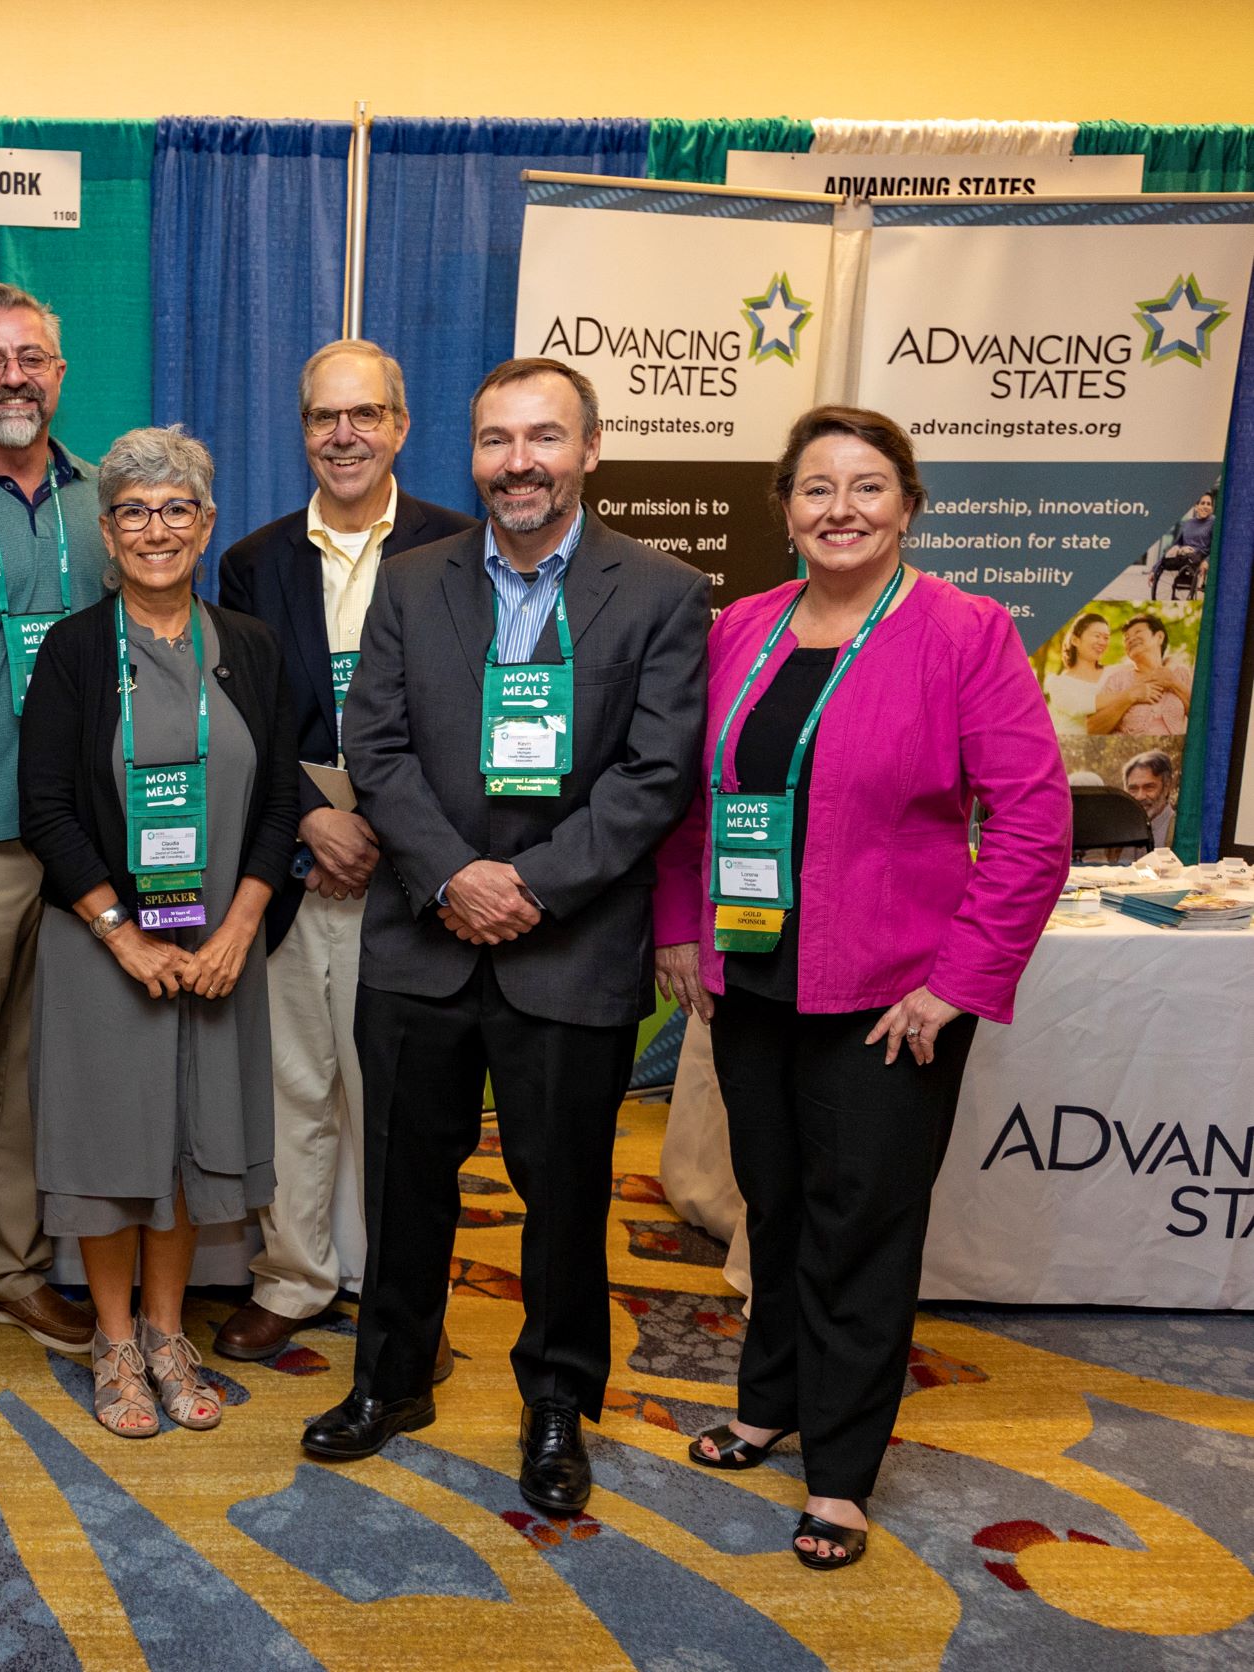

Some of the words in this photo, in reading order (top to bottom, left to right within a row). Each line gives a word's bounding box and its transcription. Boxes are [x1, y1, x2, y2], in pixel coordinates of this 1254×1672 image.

[824, 176, 951, 198] ADVANCING
[958, 177, 1036, 195] STATES
[53, 211, 77, 221] 1100
[540, 316, 741, 361] ADVANCING
[887, 327, 1132, 366] ADVANCING
[628, 364, 738, 397] STATES
[990, 369, 1127, 400] STATES
[598, 415, 734, 437] ancingstates.org
[910, 419, 1122, 438] advancingstates.org
[598, 498, 627, 516] Our
[631, 498, 690, 516] mission
[695, 498, 708, 516] is
[712, 499, 729, 515] to
[923, 498, 1032, 517] Leadership,
[1038, 498, 1150, 518] innovation,
[696, 534, 727, 550] and
[1028, 532, 1055, 549] for
[1061, 533, 1111, 550] state
[943, 567, 978, 583] and
[983, 567, 1073, 587] Disability
[23, 635, 45, 645] MEA
[331, 658, 353, 669] M'S
[332, 671, 354, 681] ALS
[503, 672, 550, 683] MOM'S
[146, 771, 187, 785] MOM'S
[726, 803, 768, 814] MOM'S
[145, 892, 197, 905] SPEAKER
